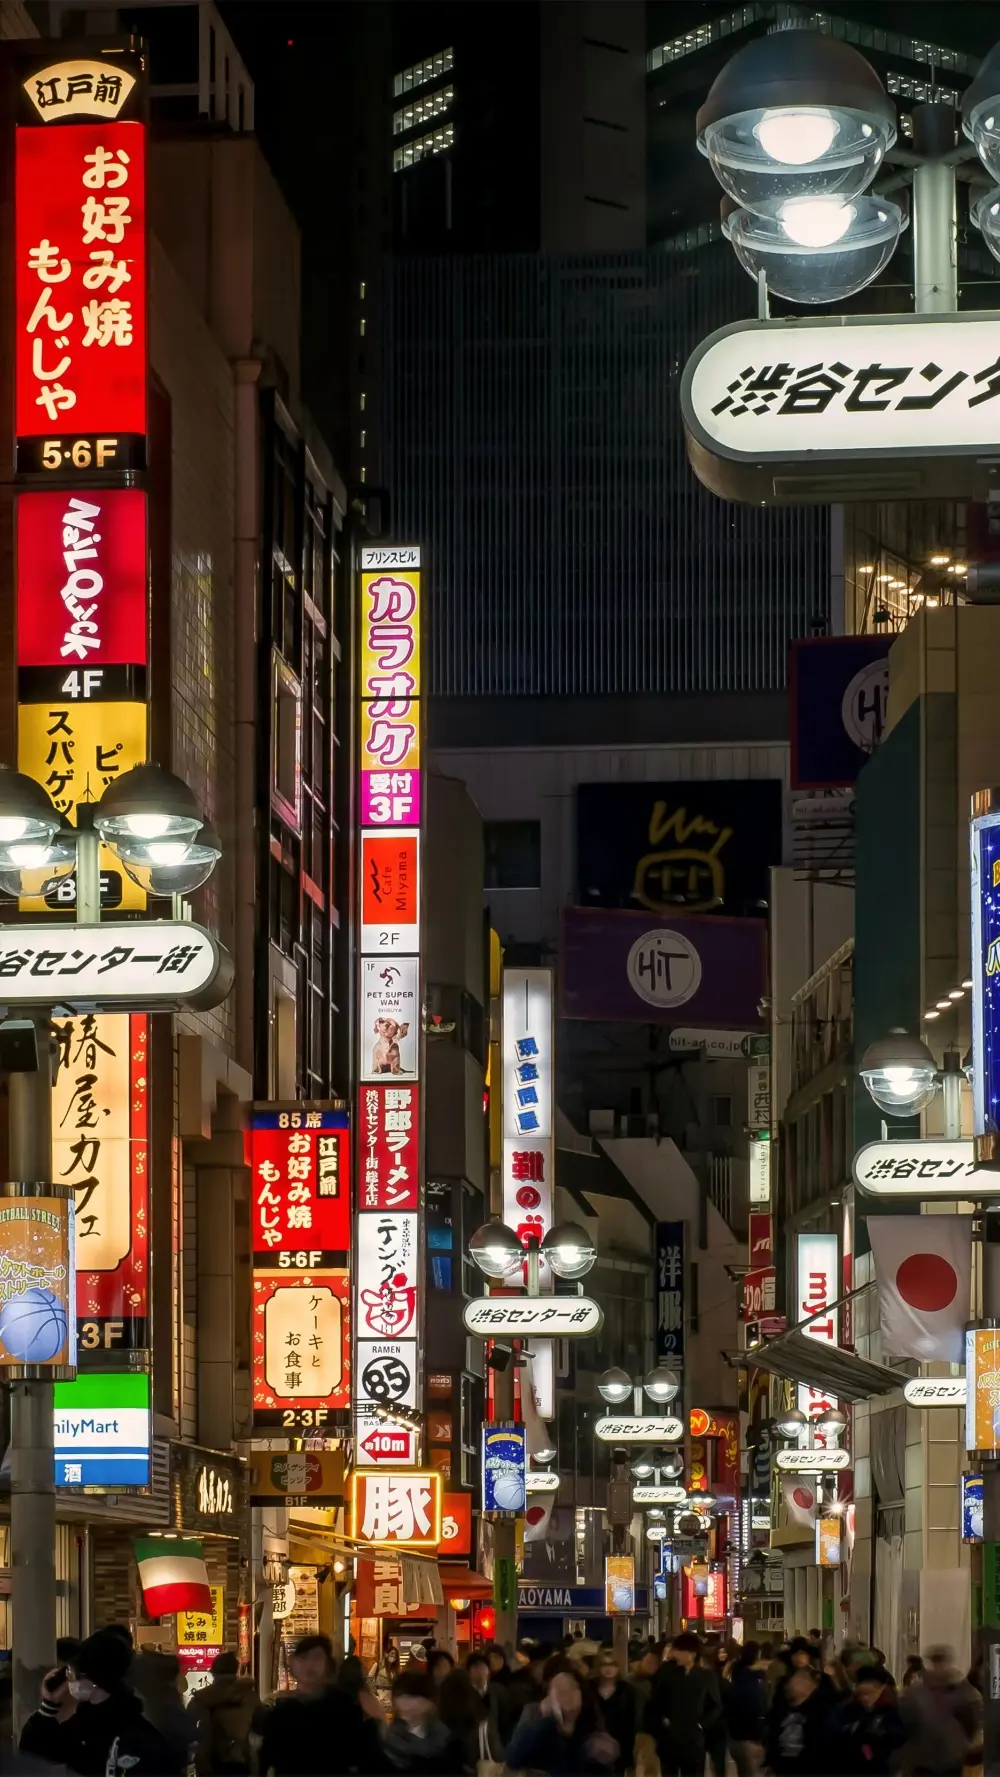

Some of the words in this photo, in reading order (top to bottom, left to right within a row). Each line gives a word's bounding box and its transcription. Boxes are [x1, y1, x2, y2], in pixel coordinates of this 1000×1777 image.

[36, 74, 123, 108] 江戸前
[82, 146, 133, 348] お好み焼
[27, 240, 76, 420] もんじゃ
[365, 550, 417, 564] プリンスビル
[62, 670, 103, 698] 4F
[367, 577, 416, 766] カラオケ
[369, 773, 412, 795] 受付
[369, 797, 411, 822] 3F
[382, 867, 392, 896] Cafe
[396, 851, 409, 911] Miyama
[379, 932, 400, 945] 2F
[0, 945, 204, 977] 谷センター街
[367, 963, 375, 971] 1F
[385, 1089, 411, 1206] 野郎ラーメン
[287, 1132, 312, 1229] お好み焼
[319, 1137, 337, 1196] 江戸前
[257, 1160, 283, 1248] もんじゃ
[377, 1218, 406, 1285] テング
[471, 1307, 593, 1322] 渋谷センター街
[308, 1295, 323, 1368] ケーキと
[284, 1332, 303, 1389] お食事
[372, 1346, 401, 1354] RAMEN
[600, 1424, 678, 1434] 渋谷センター街
[64, 1463, 82, 1483] 酒
[285, 1496, 307, 1506] B1F
[361, 1476, 432, 1540] 豚
[518, 1588, 572, 1606] AOYAMA
